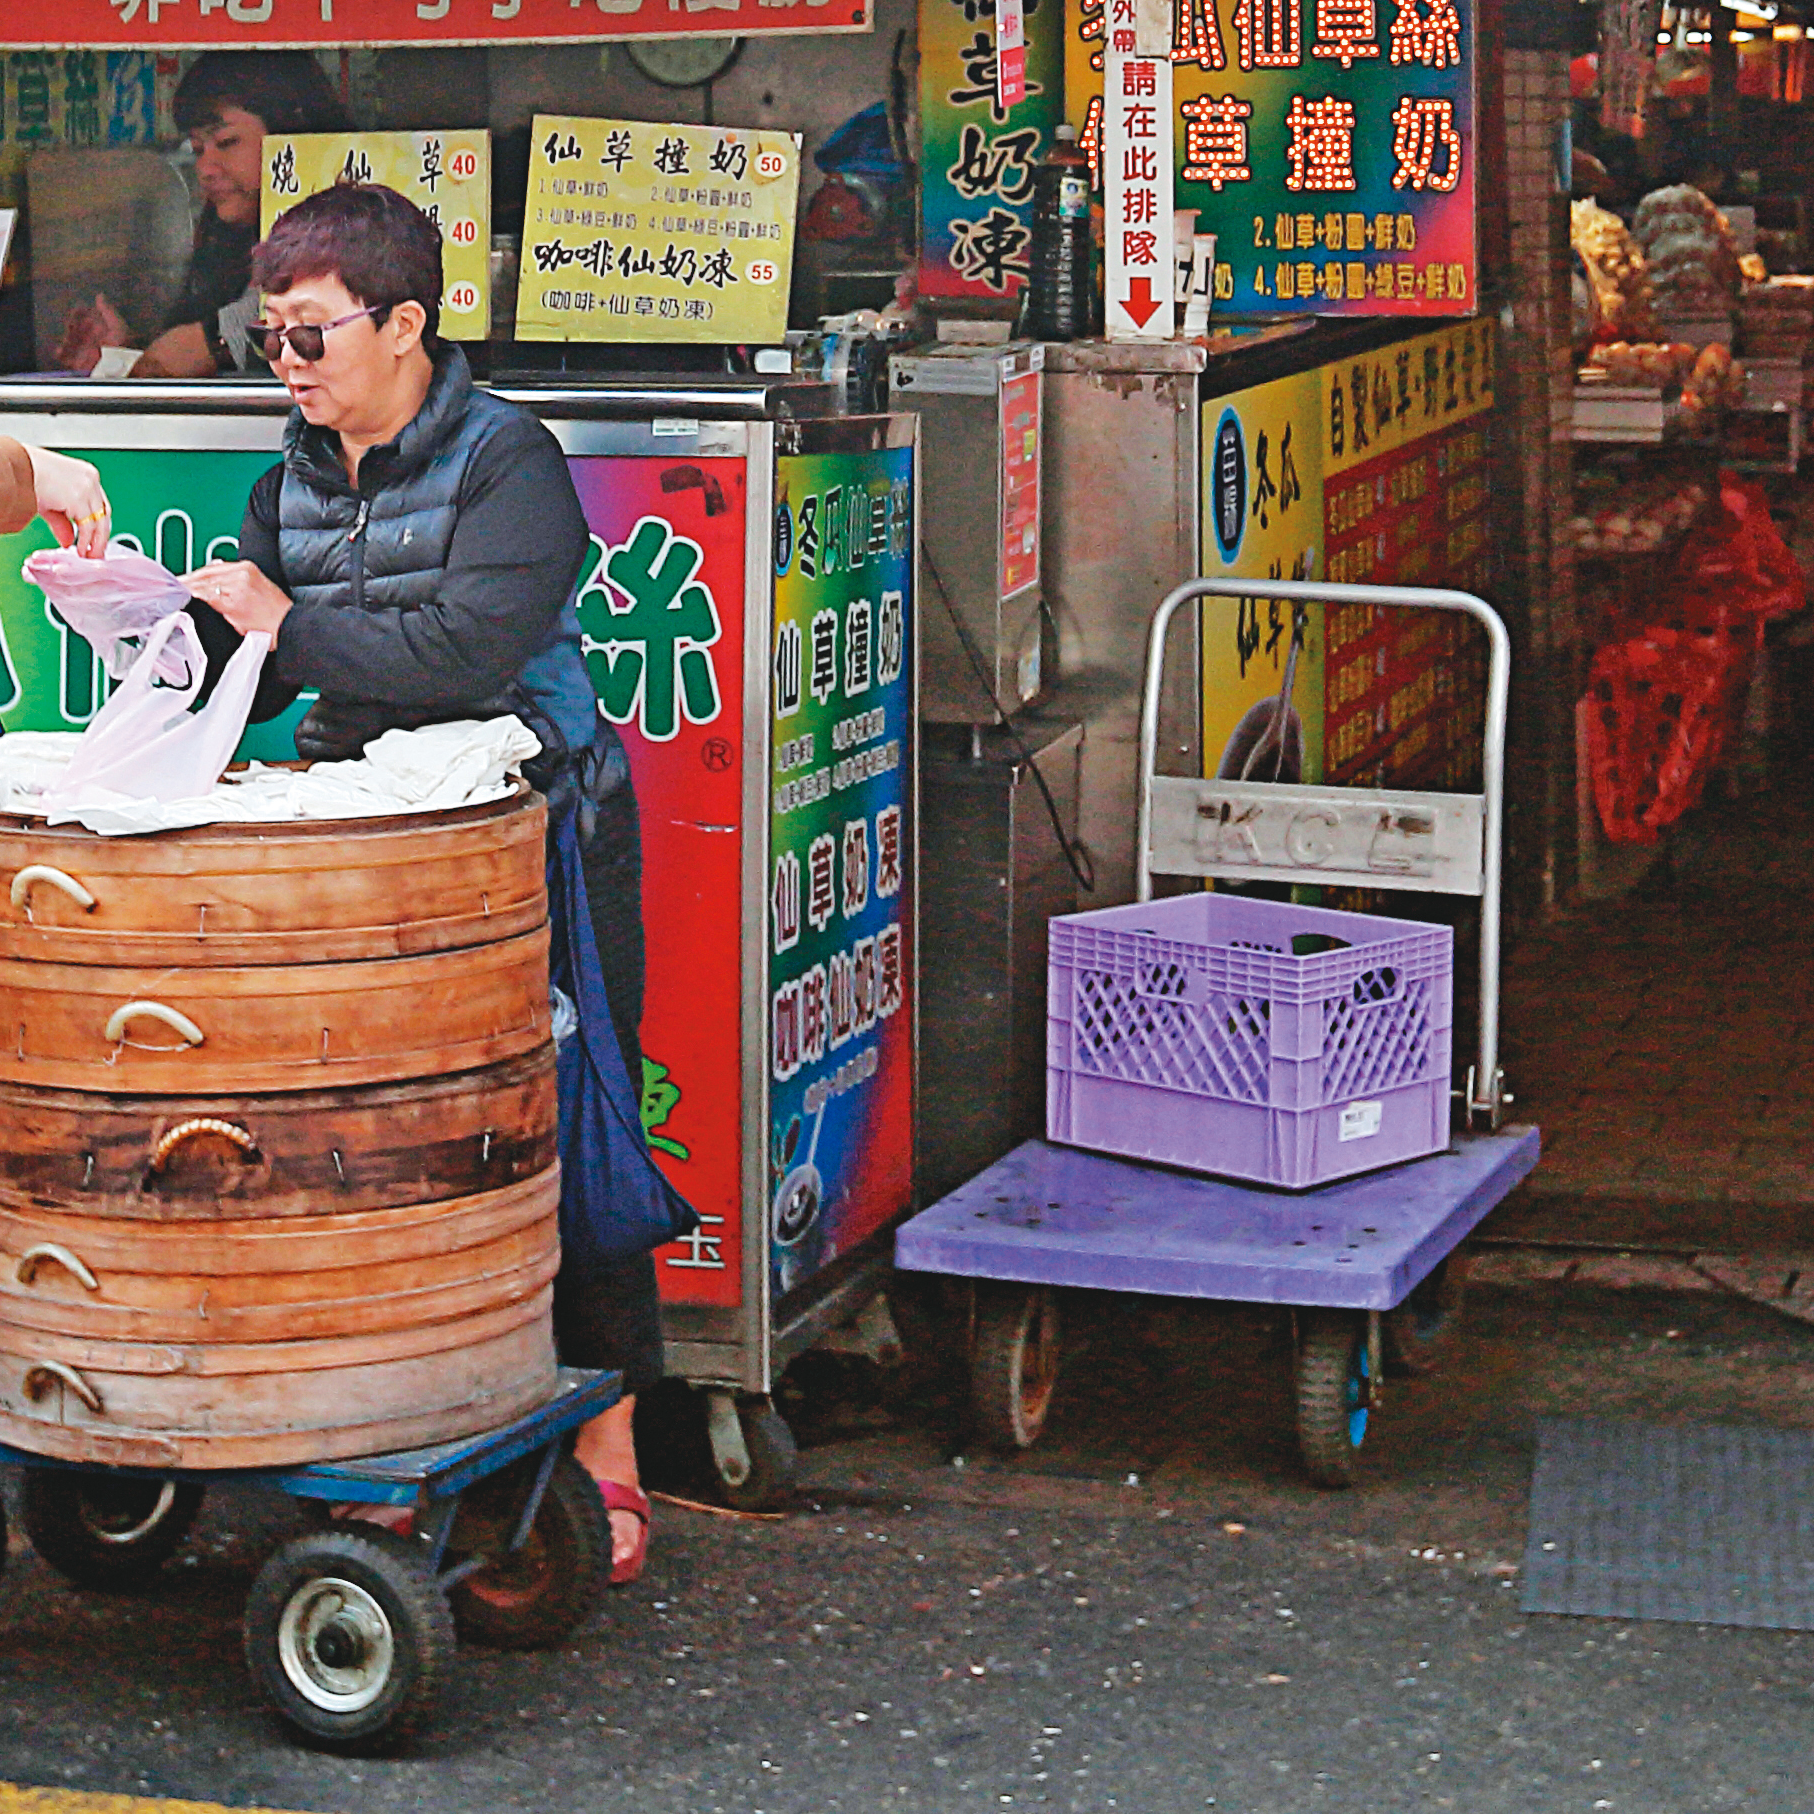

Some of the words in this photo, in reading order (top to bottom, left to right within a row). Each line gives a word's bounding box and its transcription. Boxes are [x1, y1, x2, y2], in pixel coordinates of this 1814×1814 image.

[1112, 0, 1136, 53] 外帶
[271, 139, 443, 194] 燒仙草
[452, 154, 476, 175] 40
[544, 130, 748, 181] 仙草撞奶
[760, 156, 782, 173] 50
[1122, 61, 1157, 267] 請在此排隊
[452, 220, 476, 242] 40
[534, 239, 739, 288] 咖啡仙奶凍
[751, 265, 774, 281] 55
[451, 288, 475, 307] 40
